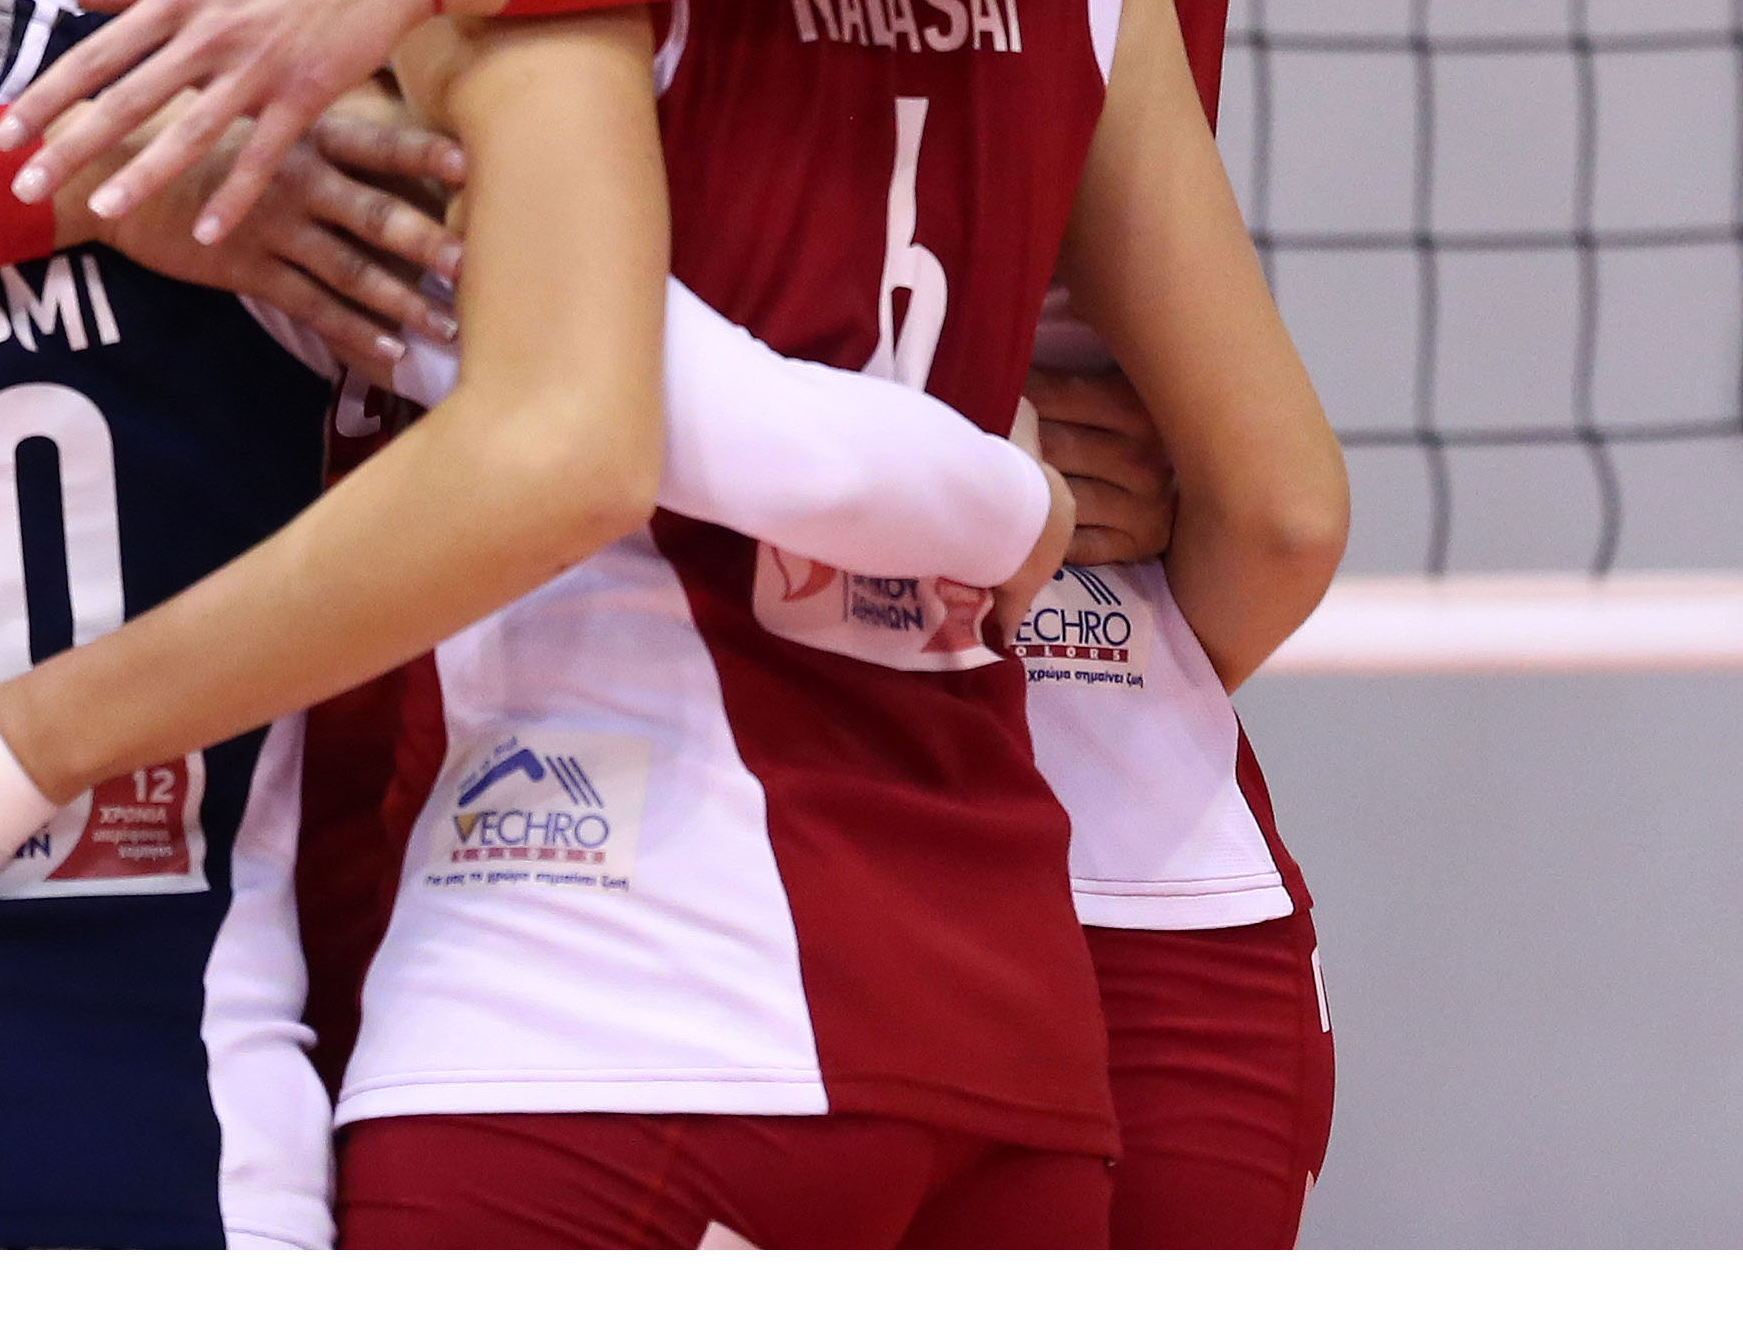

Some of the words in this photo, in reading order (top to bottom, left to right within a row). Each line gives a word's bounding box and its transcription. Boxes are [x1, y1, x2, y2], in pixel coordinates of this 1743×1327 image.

[1015, 608, 1132, 647] ECHRO
[1014, 646, 1122, 662] OLORS
[133, 768, 176, 804] 12
[453, 810, 611, 848] VECHRO
